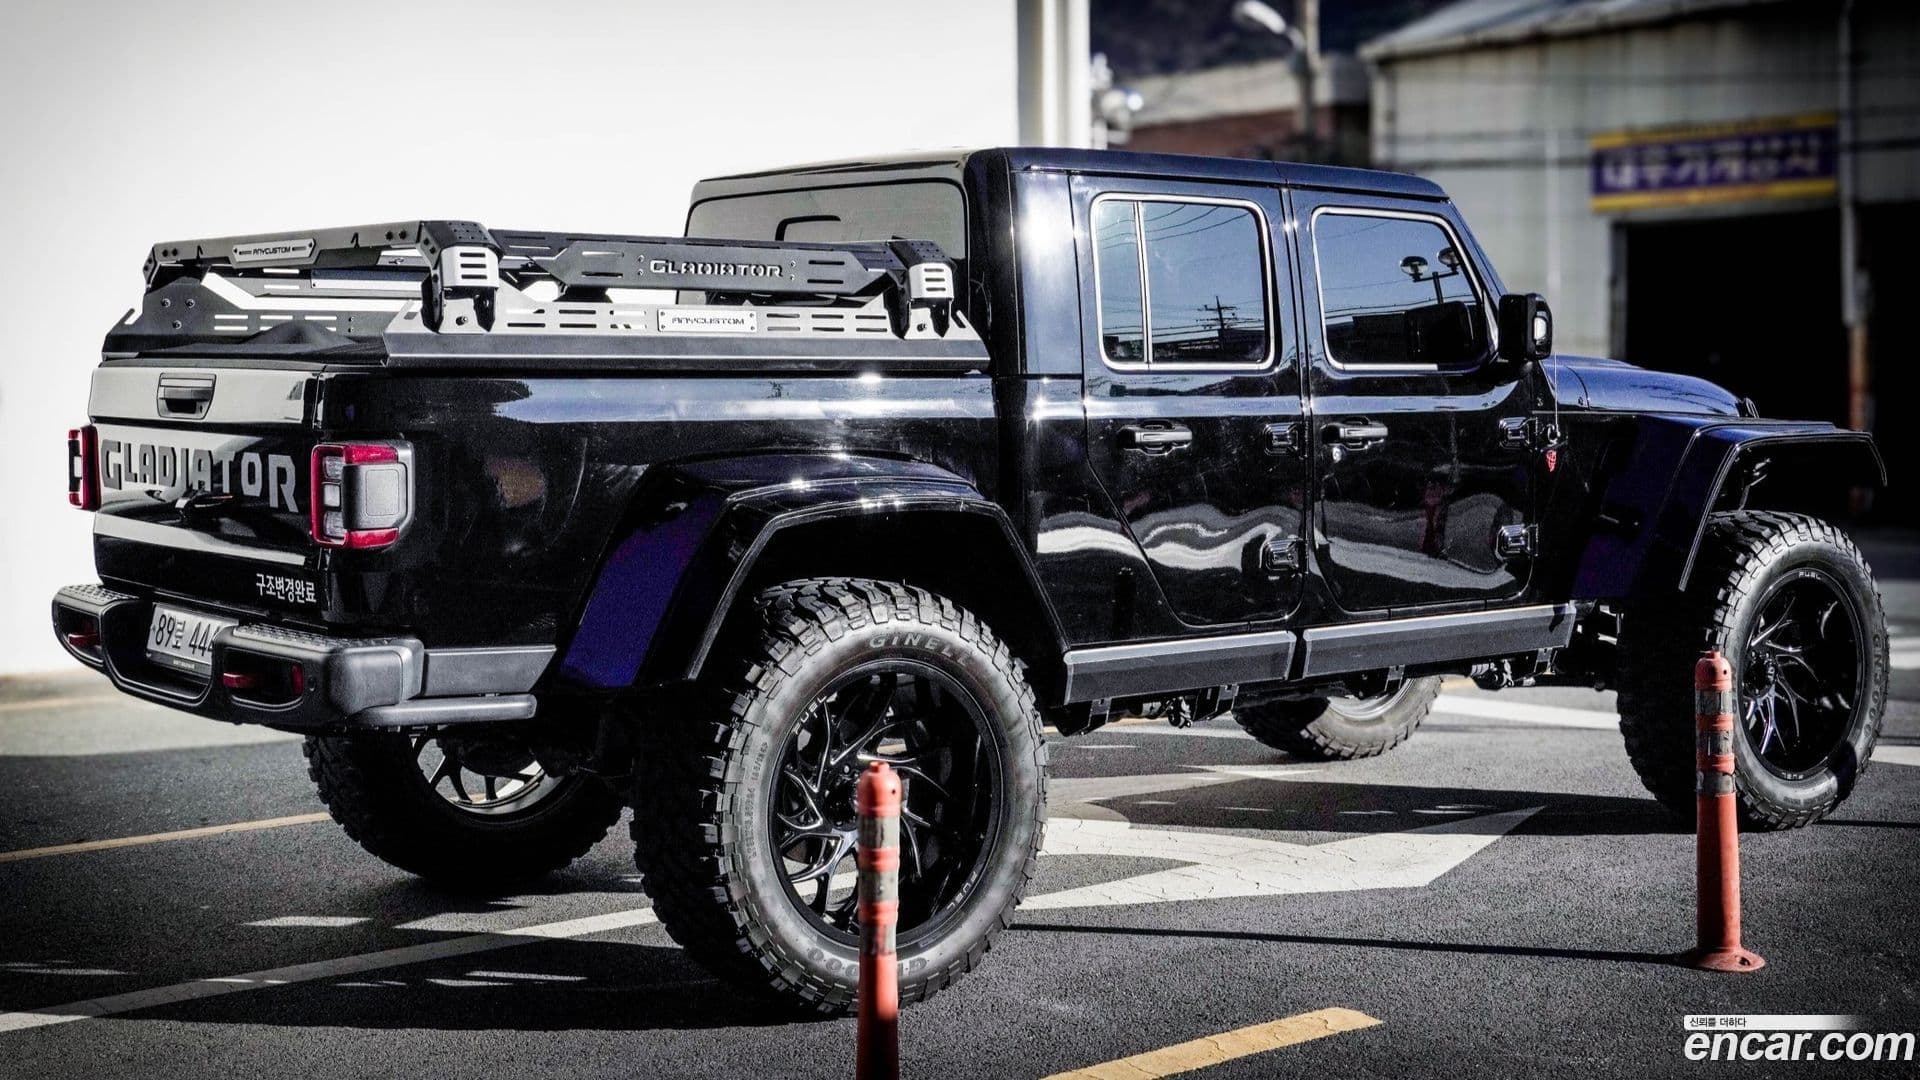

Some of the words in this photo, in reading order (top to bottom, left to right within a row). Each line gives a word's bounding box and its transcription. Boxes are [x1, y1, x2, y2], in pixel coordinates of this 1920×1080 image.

[252, 246, 291, 256] ANYCUSTOM
[649, 259, 783, 277] GLADIATOR
[101, 439, 299, 513] GLADIATOR
[256, 573, 317, 603] 구조변경완료
[155, 614, 186, 649] 89로
